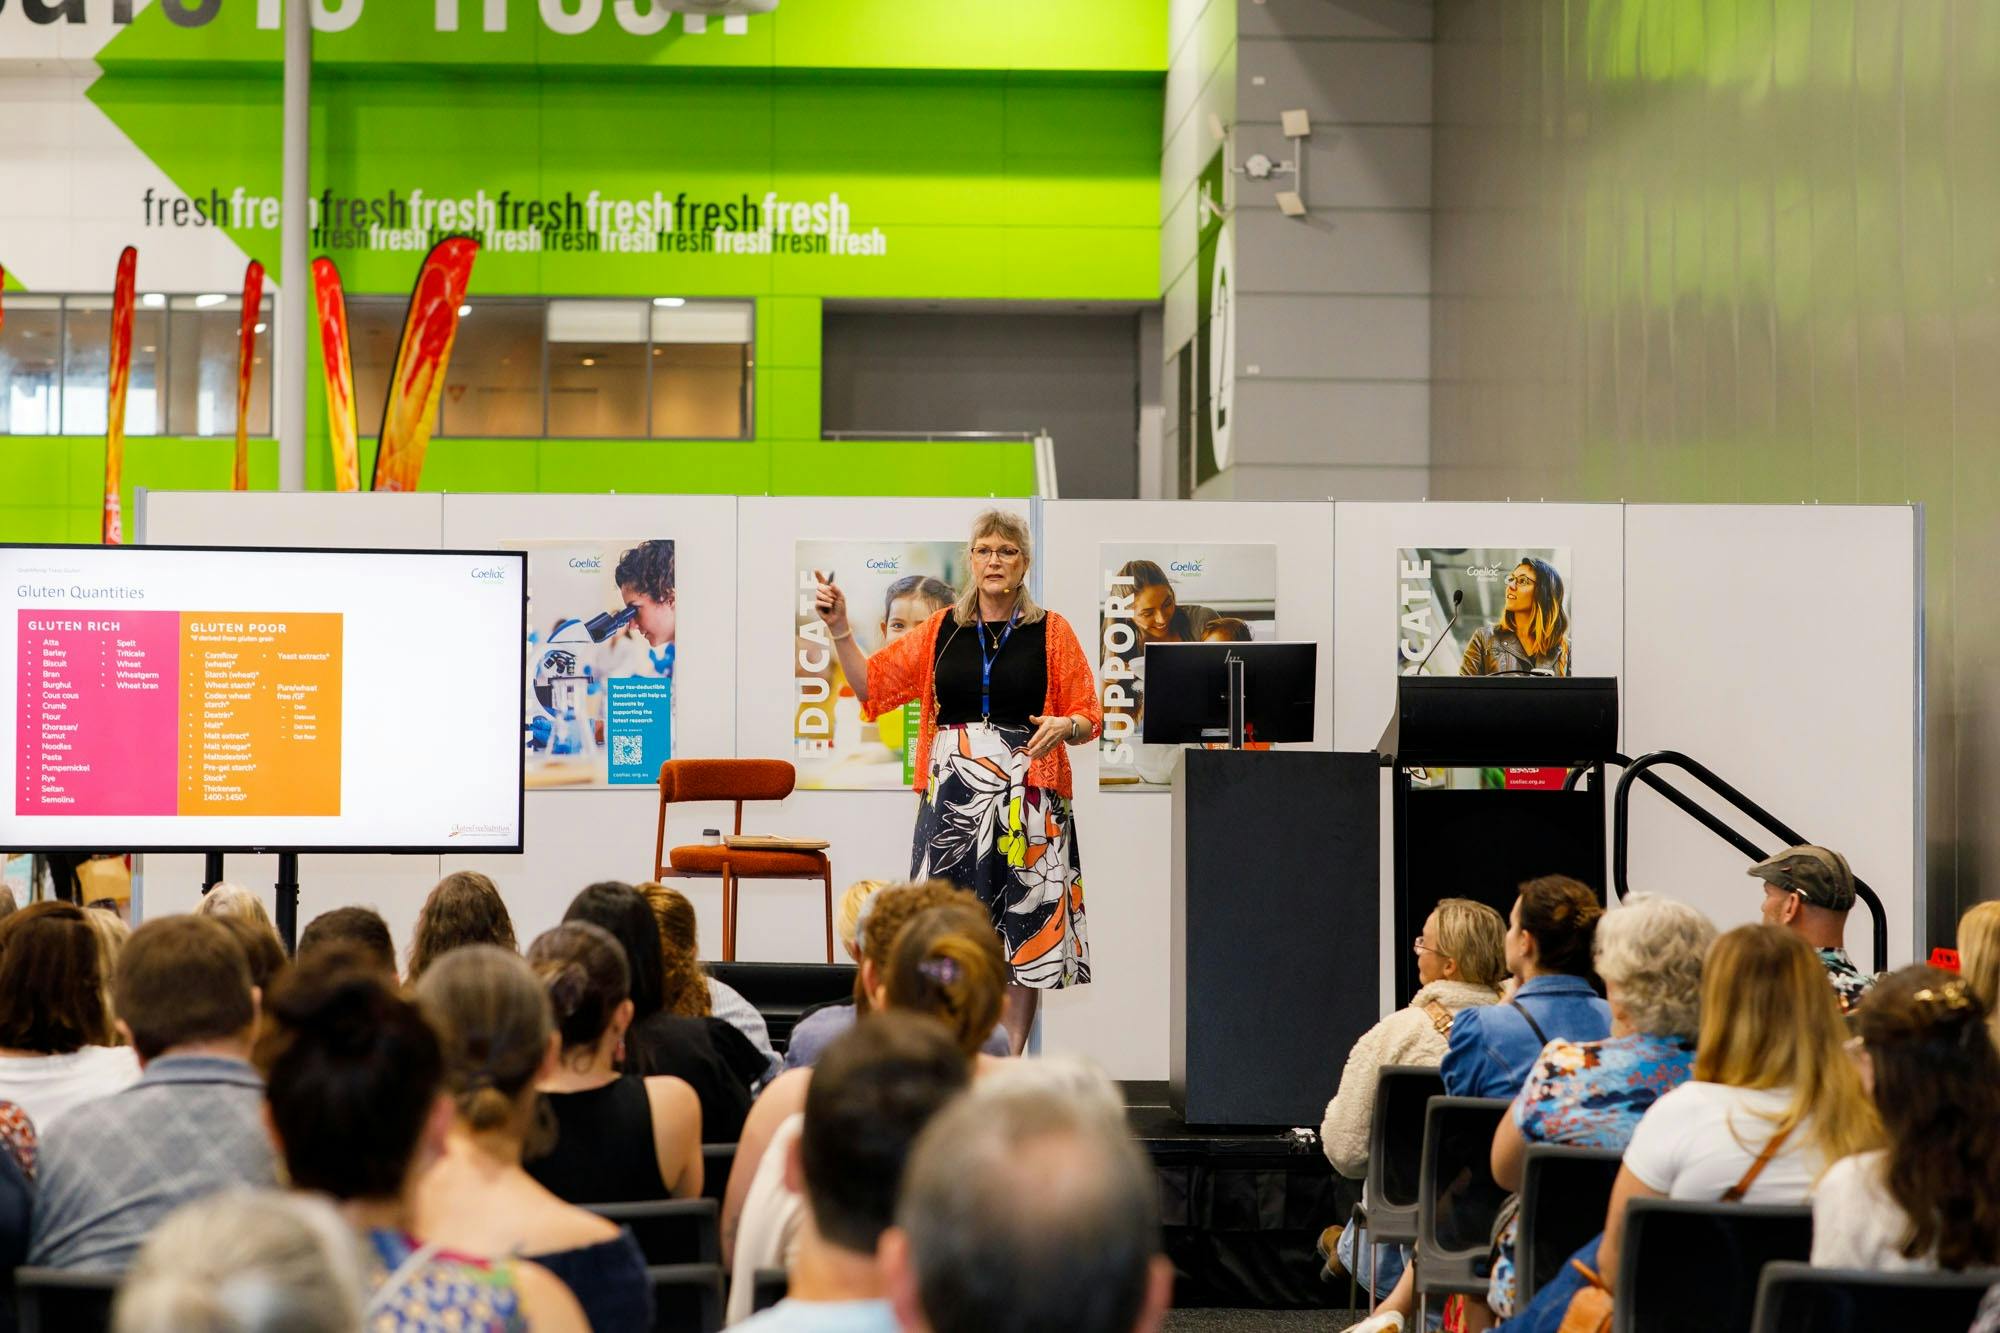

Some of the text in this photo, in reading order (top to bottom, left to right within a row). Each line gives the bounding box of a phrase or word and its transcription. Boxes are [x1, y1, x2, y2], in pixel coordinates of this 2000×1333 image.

[568, 558, 601, 568] Coeliac
[866, 558, 898, 569] Coeliac
[1170, 561, 1202, 572] Coeliac
[471, 568, 504, 579] Coeliac
[1466, 566, 1498, 576] Coeliac
[17, 585, 145, 599] Gluten Quantities
[28, 621, 120, 631] GLUTEN RICH
[190, 623, 287, 633] GLUTEN POOR
[117, 640, 136, 648] Spelt
[43, 649, 66, 657] Barley
[277, 652, 297, 660] Yeast
[117, 660, 141, 668] Wheat
[1104, 569, 1135, 764] SUPPORT
[117, 671, 159, 679] Wheatgerm
[43, 681, 72, 690] Burghul
[42, 702, 67, 710] Crumb
[42, 764, 90, 772] Pumpernickel
[42, 775, 56, 783] Rye
